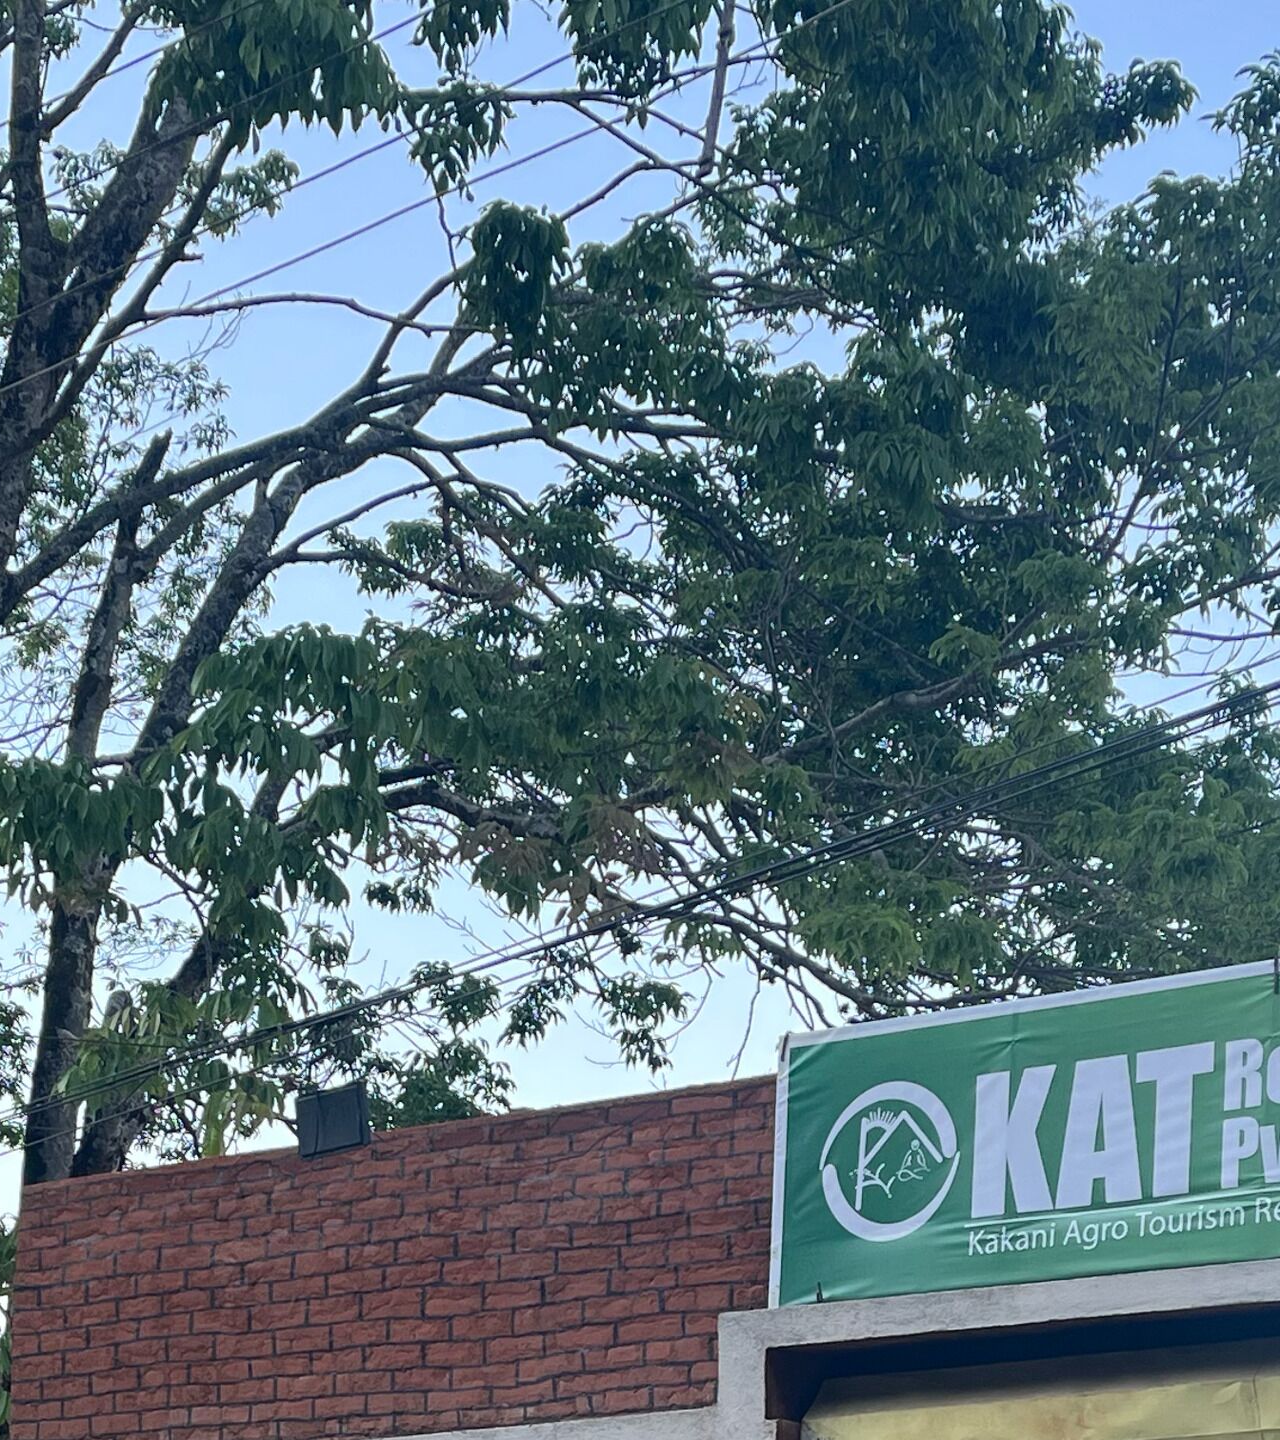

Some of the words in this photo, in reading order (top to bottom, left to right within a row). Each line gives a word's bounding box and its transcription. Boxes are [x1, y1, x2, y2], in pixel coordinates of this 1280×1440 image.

[971, 1041, 1215, 1218] KAT
[968, 1222, 1057, 1256] Kakani
[1063, 1219, 1129, 1250] Agro
[1136, 1205, 1245, 1238] Tourism
